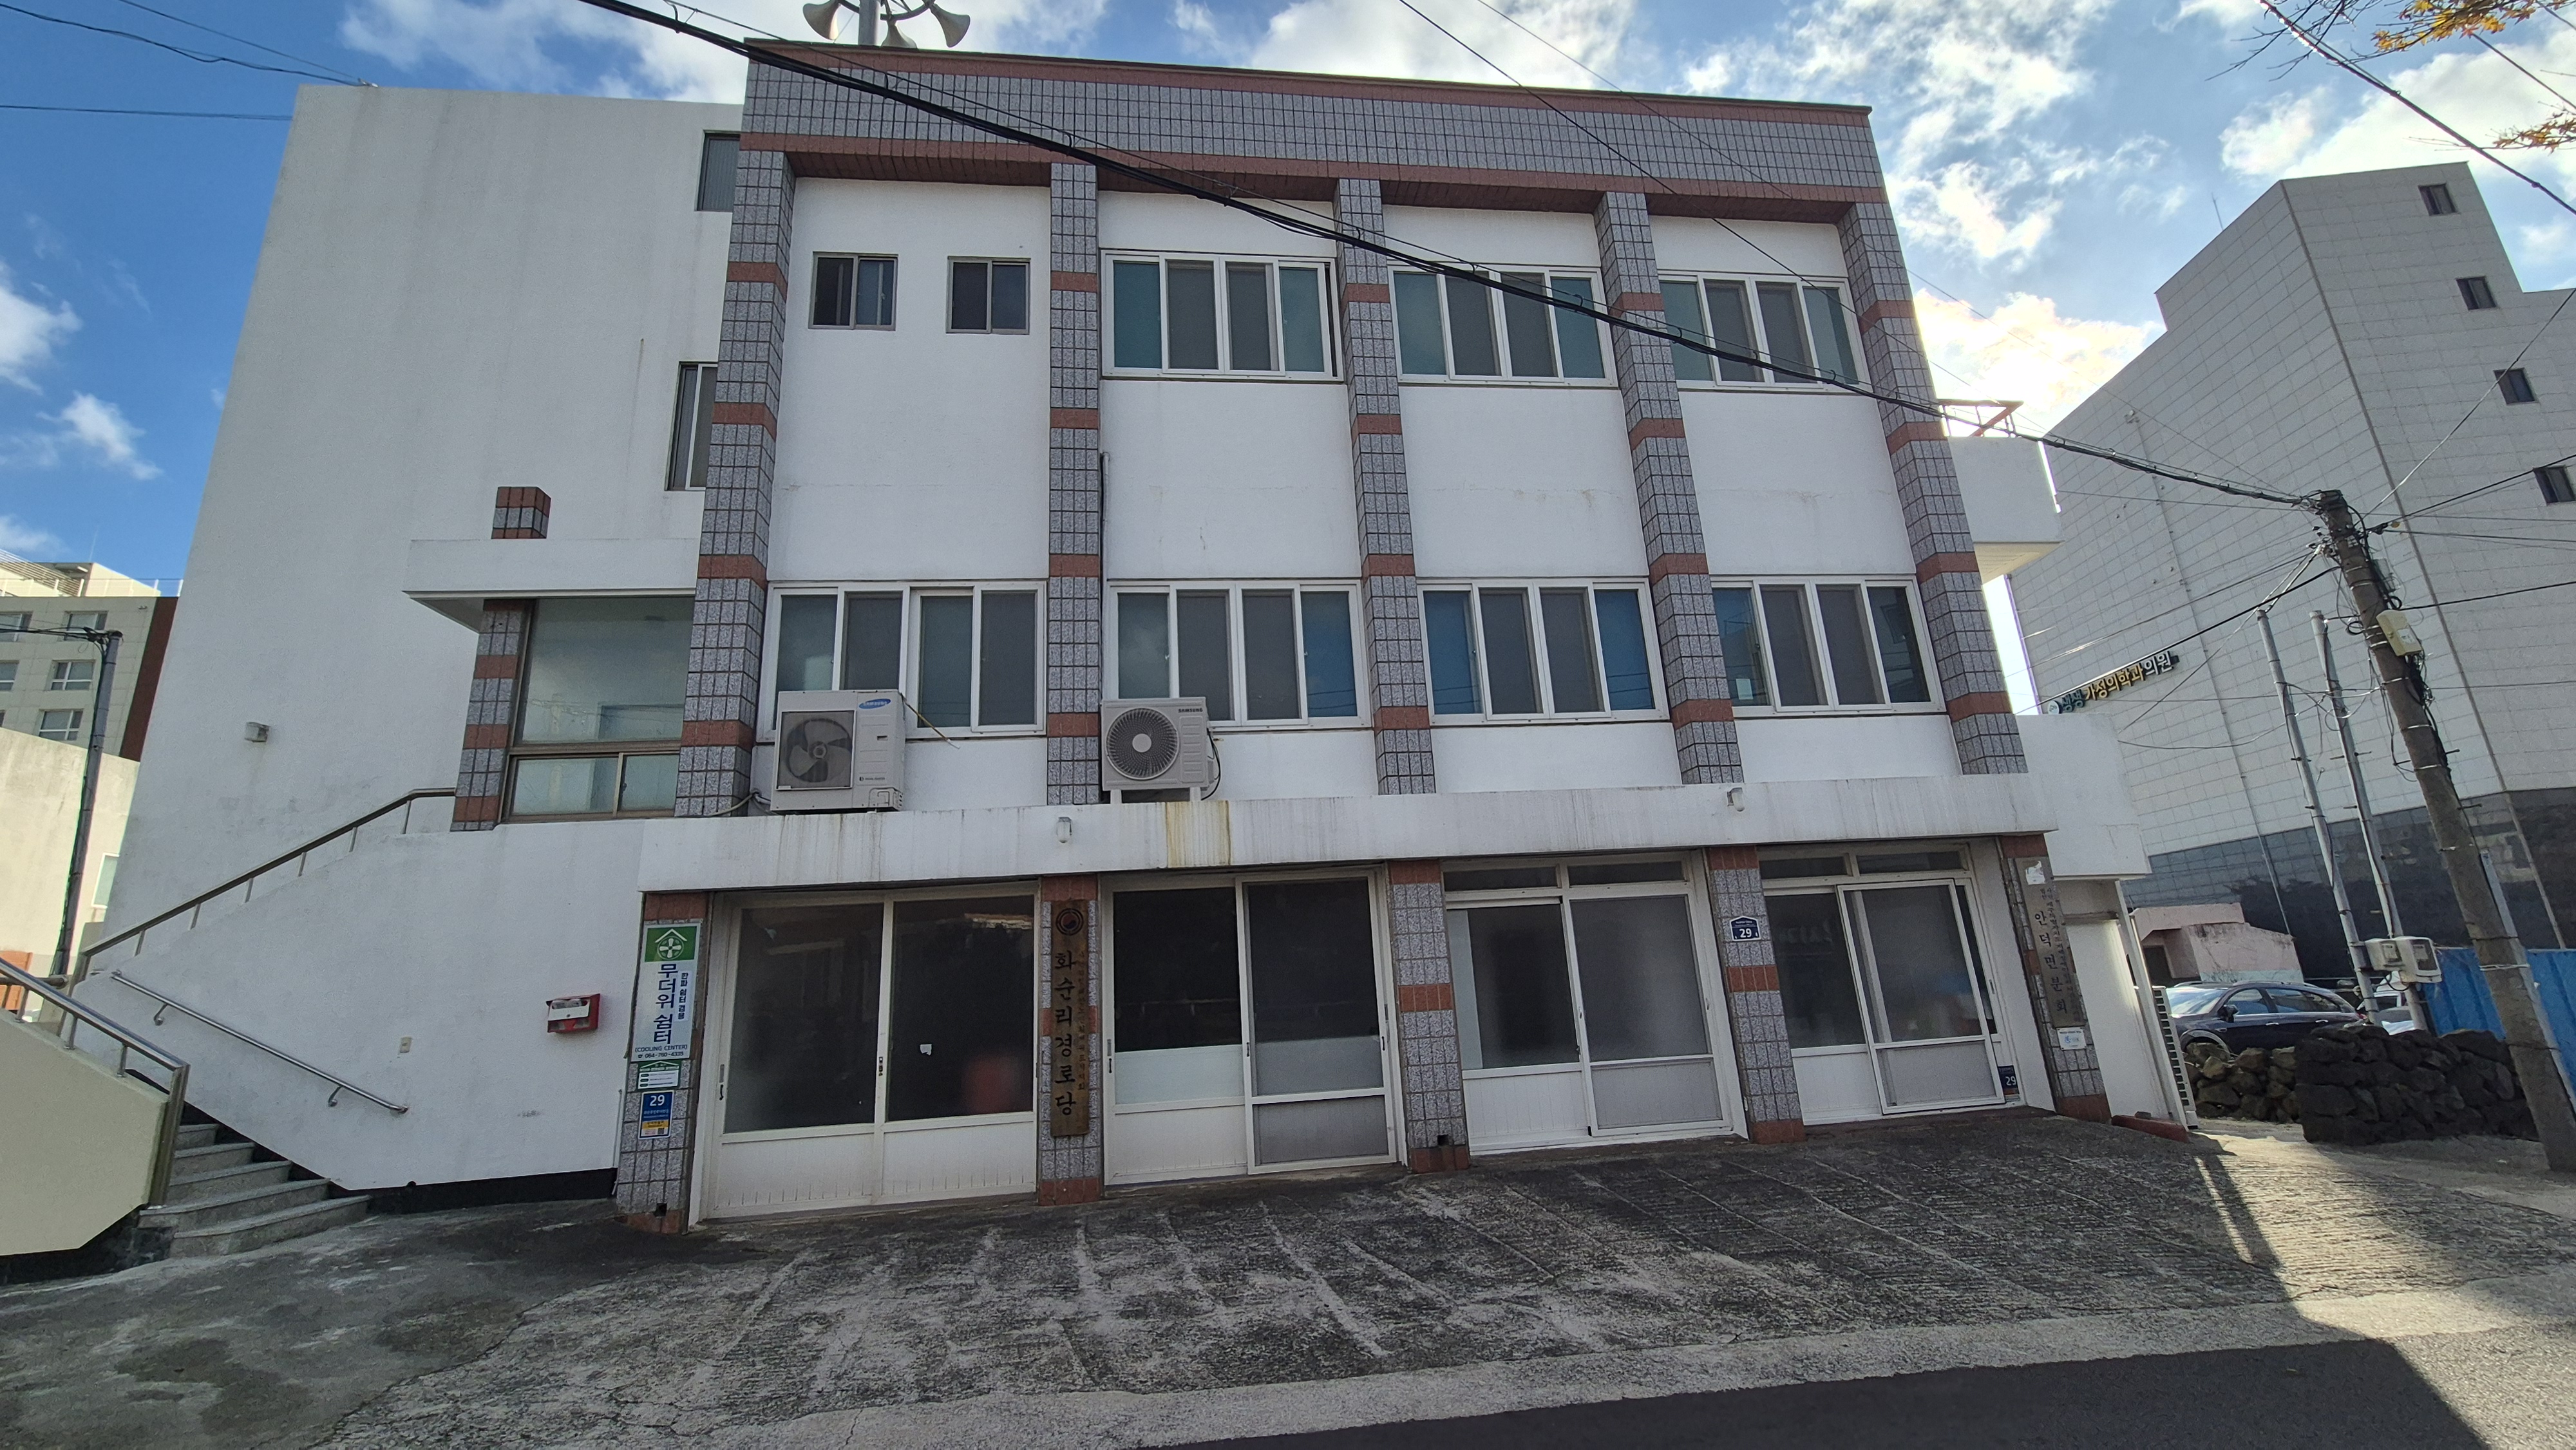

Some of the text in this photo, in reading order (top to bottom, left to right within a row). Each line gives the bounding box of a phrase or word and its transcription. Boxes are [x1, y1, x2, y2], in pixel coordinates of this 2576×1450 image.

[1739, 928, 1752, 938] 29
[656, 963, 678, 1009] 무더위
[653, 1013, 673, 1044] 쉼터
[2005, 1075, 2016, 1086] 29
[650, 1095, 665, 1106] 29
